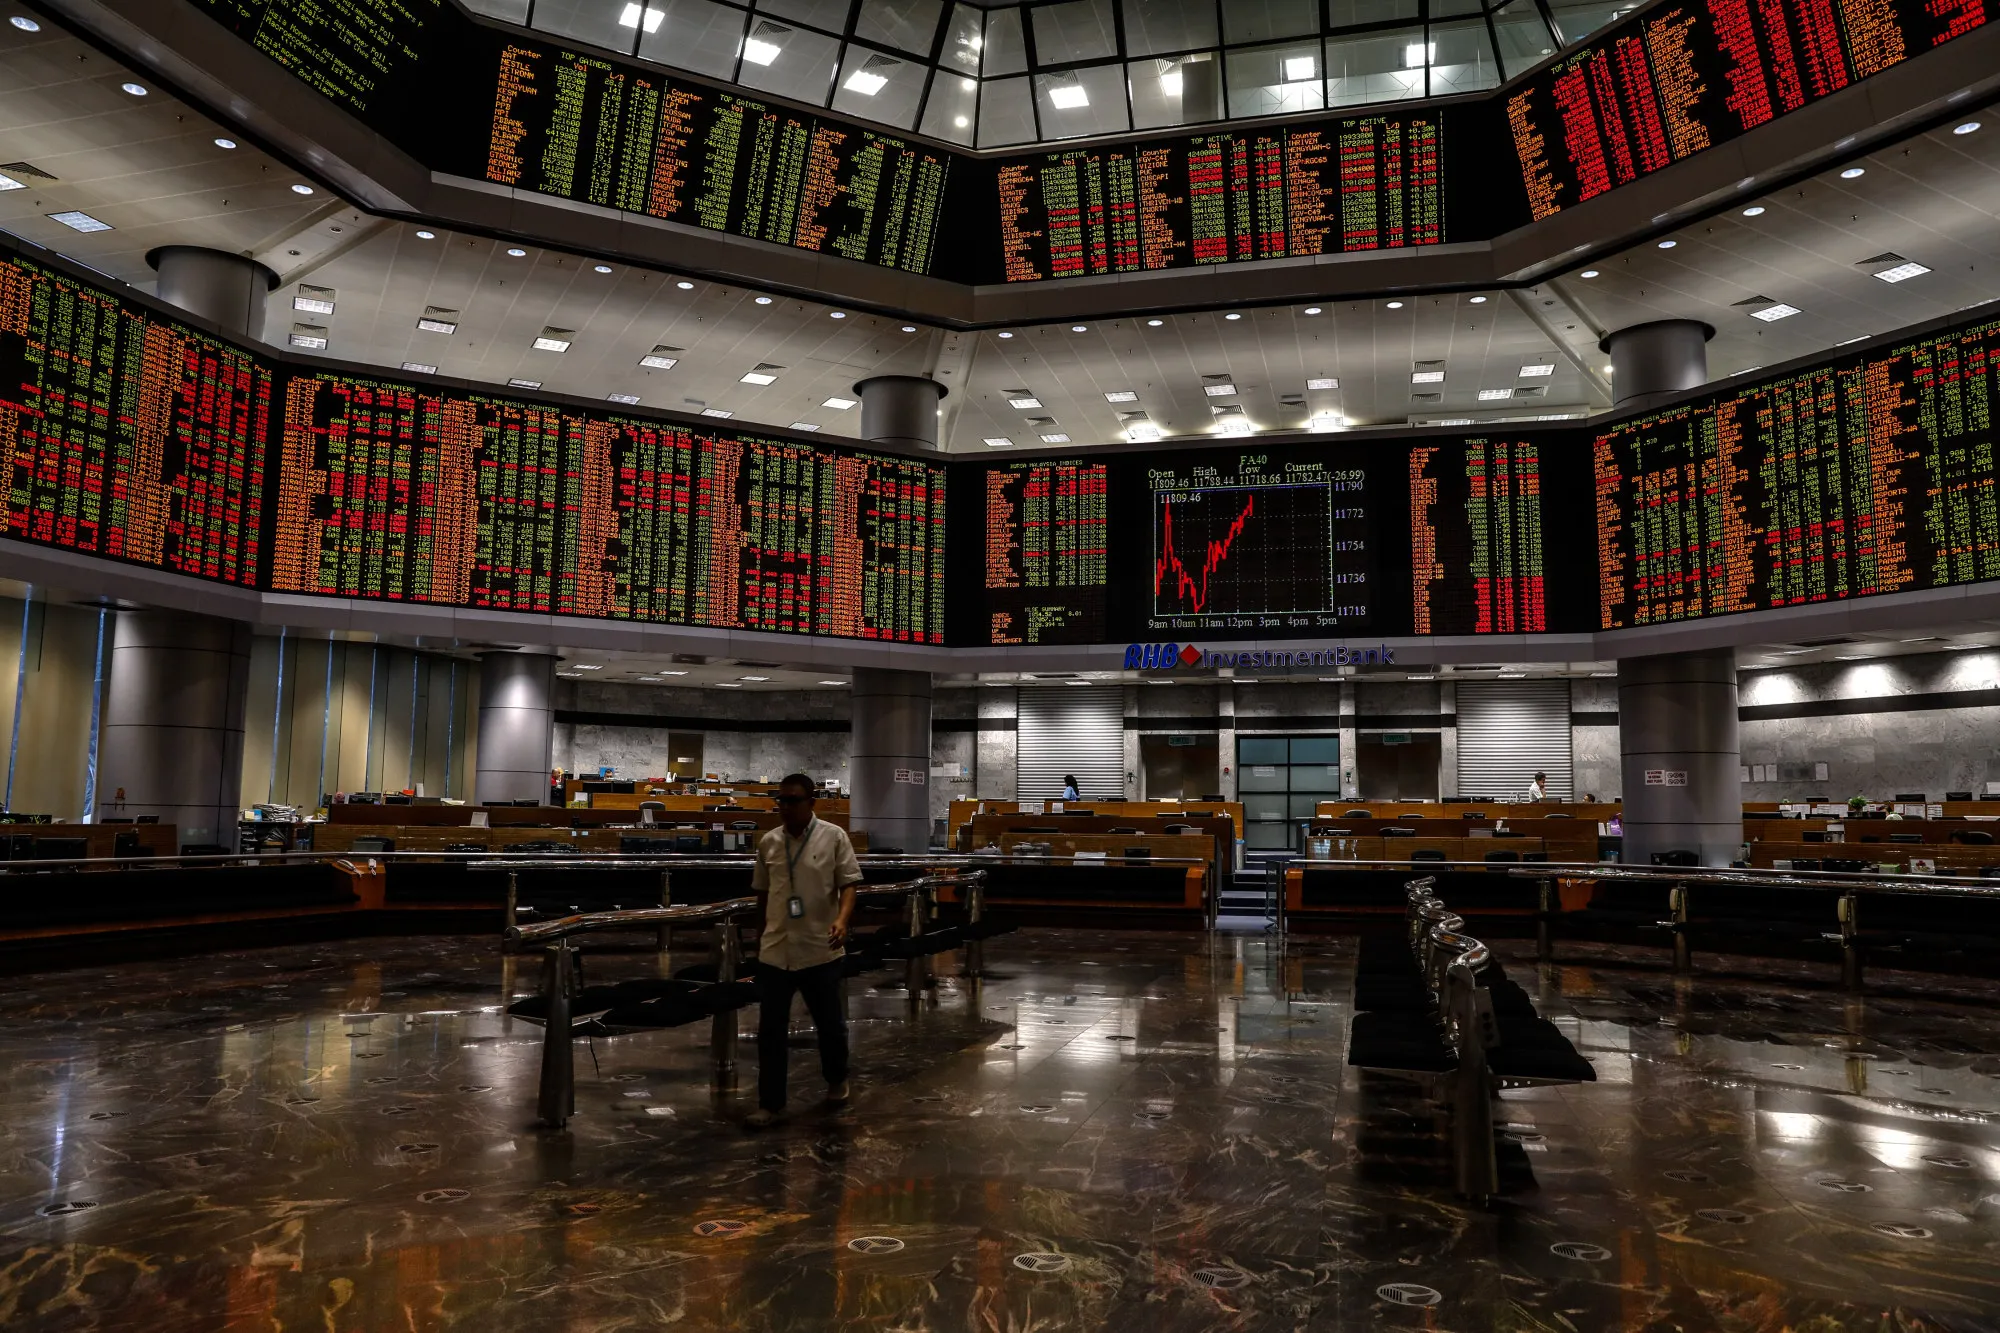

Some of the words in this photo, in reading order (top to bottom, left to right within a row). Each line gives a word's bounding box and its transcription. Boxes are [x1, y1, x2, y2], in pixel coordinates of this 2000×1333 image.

[508, 45, 541, 58] Counter
[561, 52, 575, 60] TOP
[574, 63, 587, 72] Vol
[1360, 117, 1386, 125] ACTIVE
[1869, 356, 1902, 368] Counter
[1240, 455, 1267, 464] FA40
[1193, 467, 1217, 476] High
[1239, 465, 1260, 474] Low
[1285, 463, 1323, 471] Current
[1149, 469, 1174, 478] Open
[1149, 479, 1189, 488] 11809.46
[1194, 477, 1234, 486] 11788.44
[1240, 475, 1281, 484] 11718.66
[1335, 482, 1363, 491] 11790
[1160, 494, 1200, 503] 11809.46
[1336, 509, 1364, 518] 11772
[1336, 541, 1364, 550] 11754
[1337, 574, 1365, 583] 11736
[1338, 607, 1366, 616] 11718
[1149, 620, 1168, 629] 9am
[1172, 619, 1196, 627] 10am
[1200, 619, 1224, 627] 11am
[1228, 618, 1253, 627] 12pm
[1259, 618, 1280, 626] 3pm
[1288, 617, 1308, 626] 4pm
[1316, 616, 1337, 625] 5pm
[1124, 643, 1180, 669] RHB
